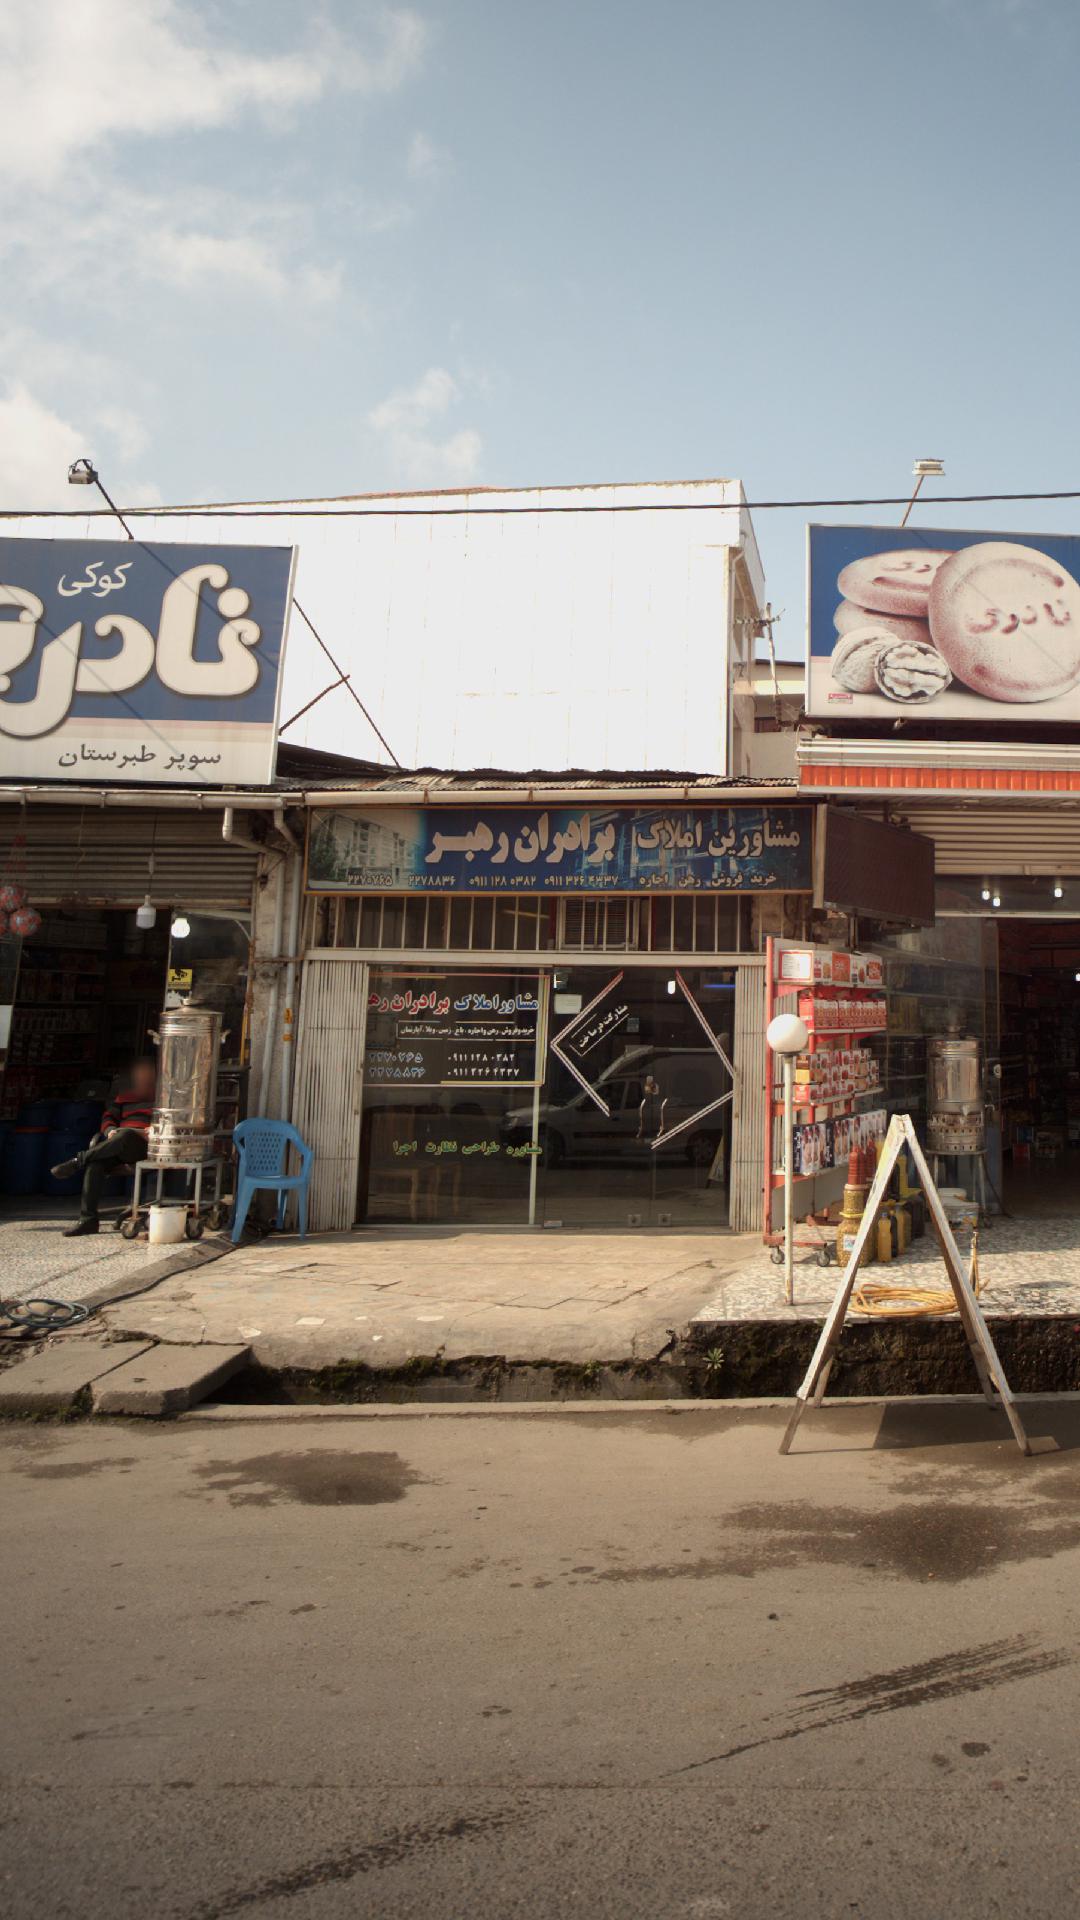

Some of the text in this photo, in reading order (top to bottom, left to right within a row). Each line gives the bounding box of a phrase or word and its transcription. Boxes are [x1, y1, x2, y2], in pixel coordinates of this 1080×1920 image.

[57, 561, 134, 597] کوکی
[58, 743, 222, 771] سوپر طبرستان
[424, 811, 801, 865] مشاورین املاک برادران رهبر
[639, 870, 777, 888] خرید فروش رهن اجاره
[390, 989, 450, 1014] برادران
